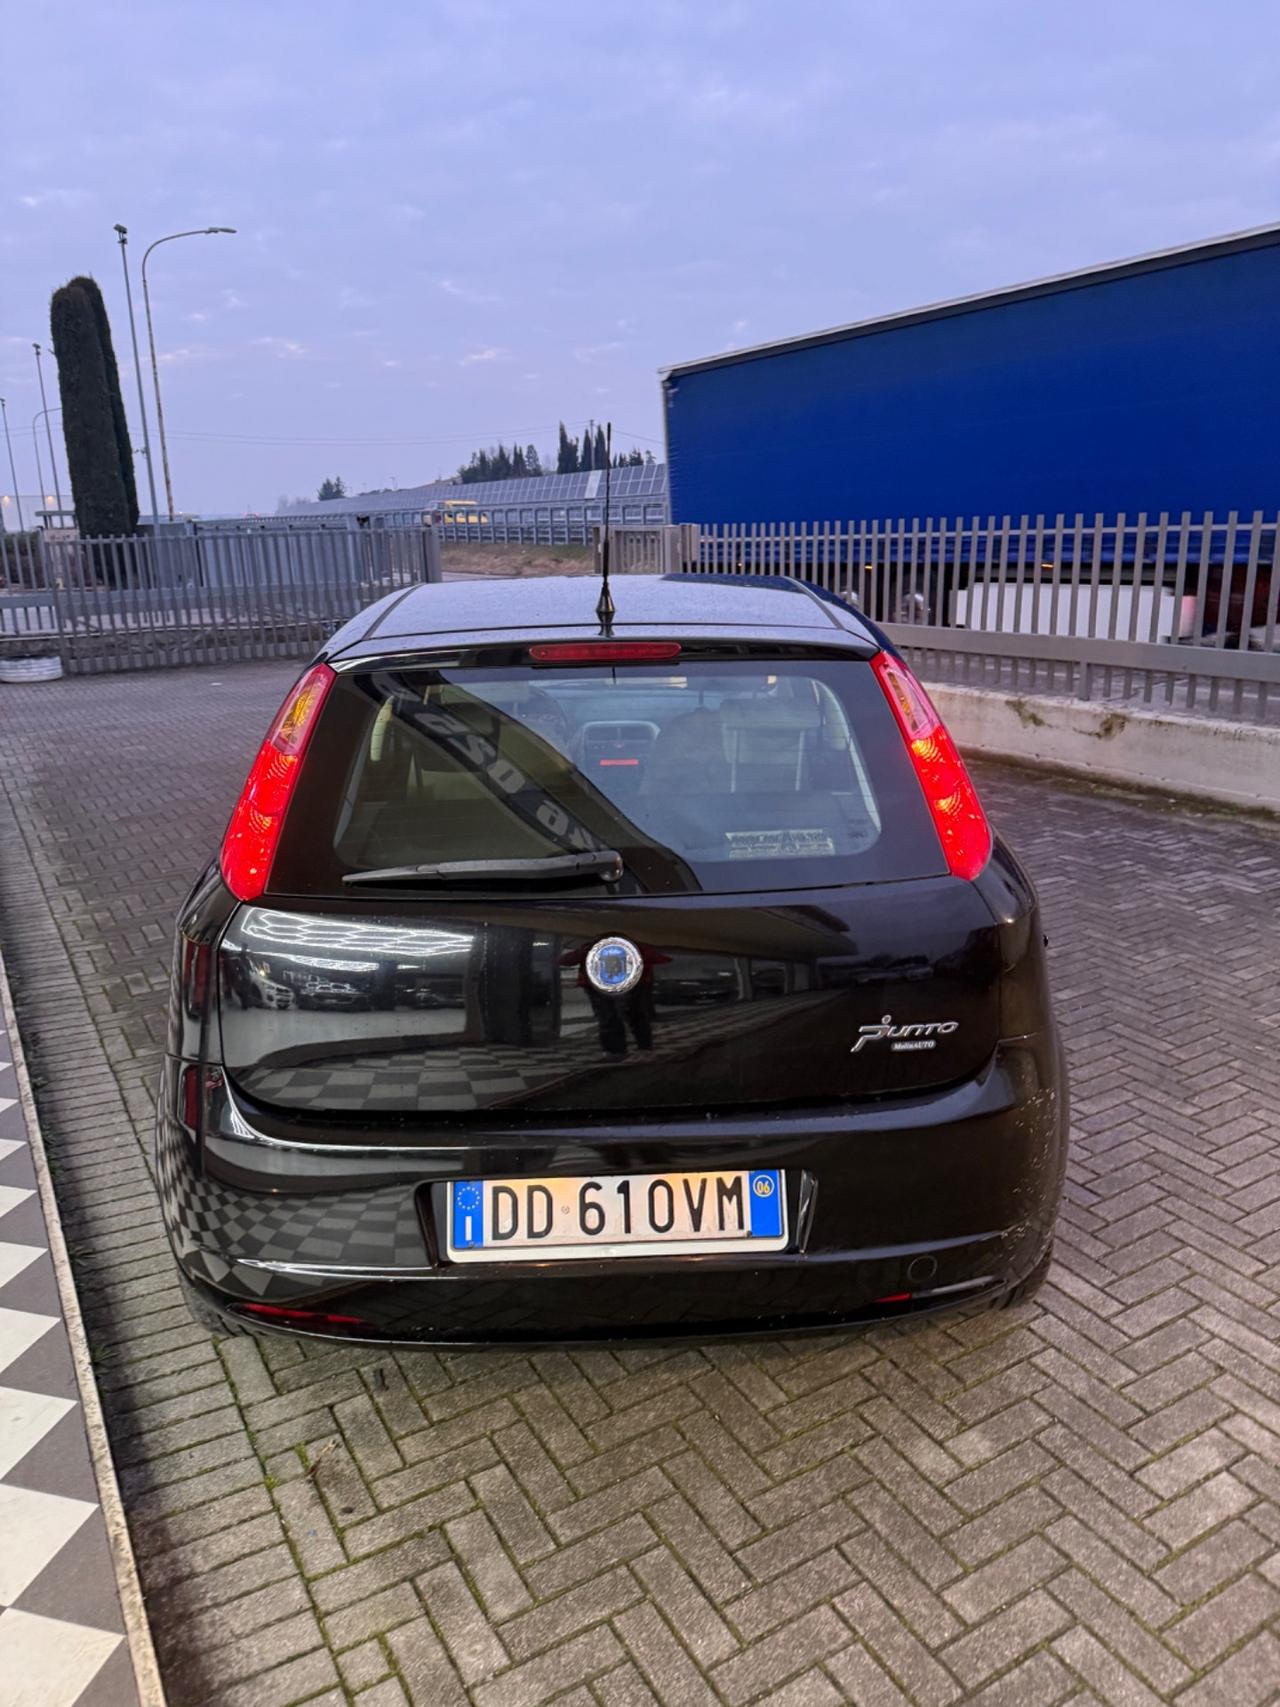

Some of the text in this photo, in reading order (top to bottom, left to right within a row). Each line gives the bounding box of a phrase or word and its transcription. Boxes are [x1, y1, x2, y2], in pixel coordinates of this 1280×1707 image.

[756, 1180, 770, 1194] 06
[492, 1175, 745, 1241] DD 610VM
